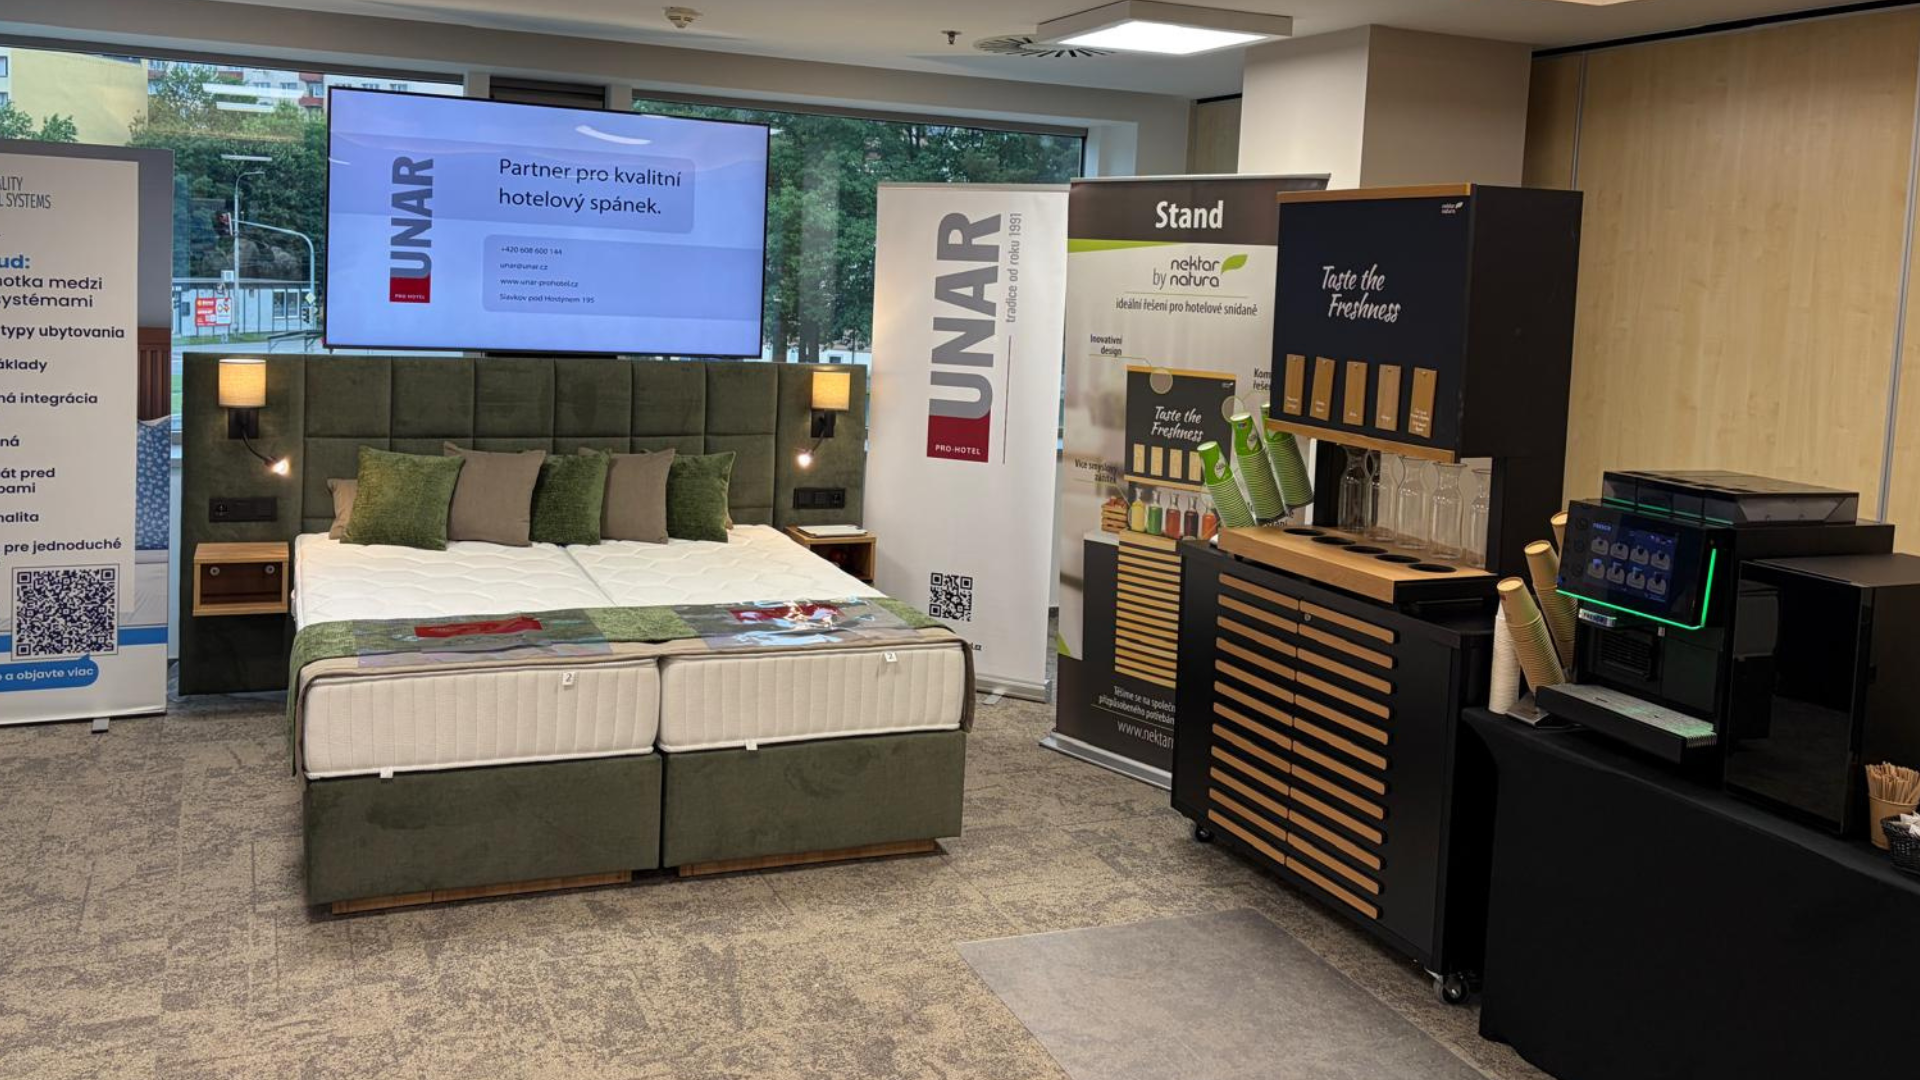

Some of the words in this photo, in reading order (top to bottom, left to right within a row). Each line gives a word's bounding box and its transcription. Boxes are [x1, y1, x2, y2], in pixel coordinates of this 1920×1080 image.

[499, 158, 571, 179] Partner
[576, 166, 608, 184] pro
[614, 166, 682, 187] kvalitní
[6, 193, 51, 209] SYSTEMS
[499, 188, 584, 213] hotelový
[590, 197, 661, 215] spánek.
[389, 155, 434, 278] UNAR
[1155, 200, 1224, 229] Stand
[1009, 212, 1022, 236] 1991
[1009, 239, 1020, 265] roku
[1170, 255, 1220, 272] nektar
[49, 277, 103, 290] medzi
[1009, 267, 1018, 282] od
[1152, 269, 1167, 290] by
[1169, 273, 1219, 288] natura
[1322, 265, 1357, 291] Taste
[1360, 264, 1386, 291] the
[0, 294, 93, 309] ystémami
[1005, 285, 1018, 323] tradice
[1115, 297, 1142, 310] ideální
[1143, 299, 1167, 312] řešení
[1169, 303, 1184, 314] pro
[1185, 300, 1223, 315] hotelové
[1223, 302, 1258, 316] snídaně
[1328, 292, 1401, 323] Freshness
[928, 212, 1002, 419] UNAR
[1, 325, 35, 340] typy
[39, 325, 125, 341] ubytovania
[1101, 346, 1122, 356] design
[20, 392, 98, 407] integrácia
[1155, 406, 1182, 422] Taste
[1184, 408, 1202, 424] the
[0, 435, 20, 447] ná
[1151, 422, 1204, 442] Freshness
[934, 444, 981, 456] PRO-HOTEL
[20, 467, 56, 481] pred
[4, 543, 29, 555] pre
[32, 537, 122, 555] jednoduché
[5, 673, 14, 681] a
[17, 670, 64, 682] objavte
[67, 667, 94, 677] viac
